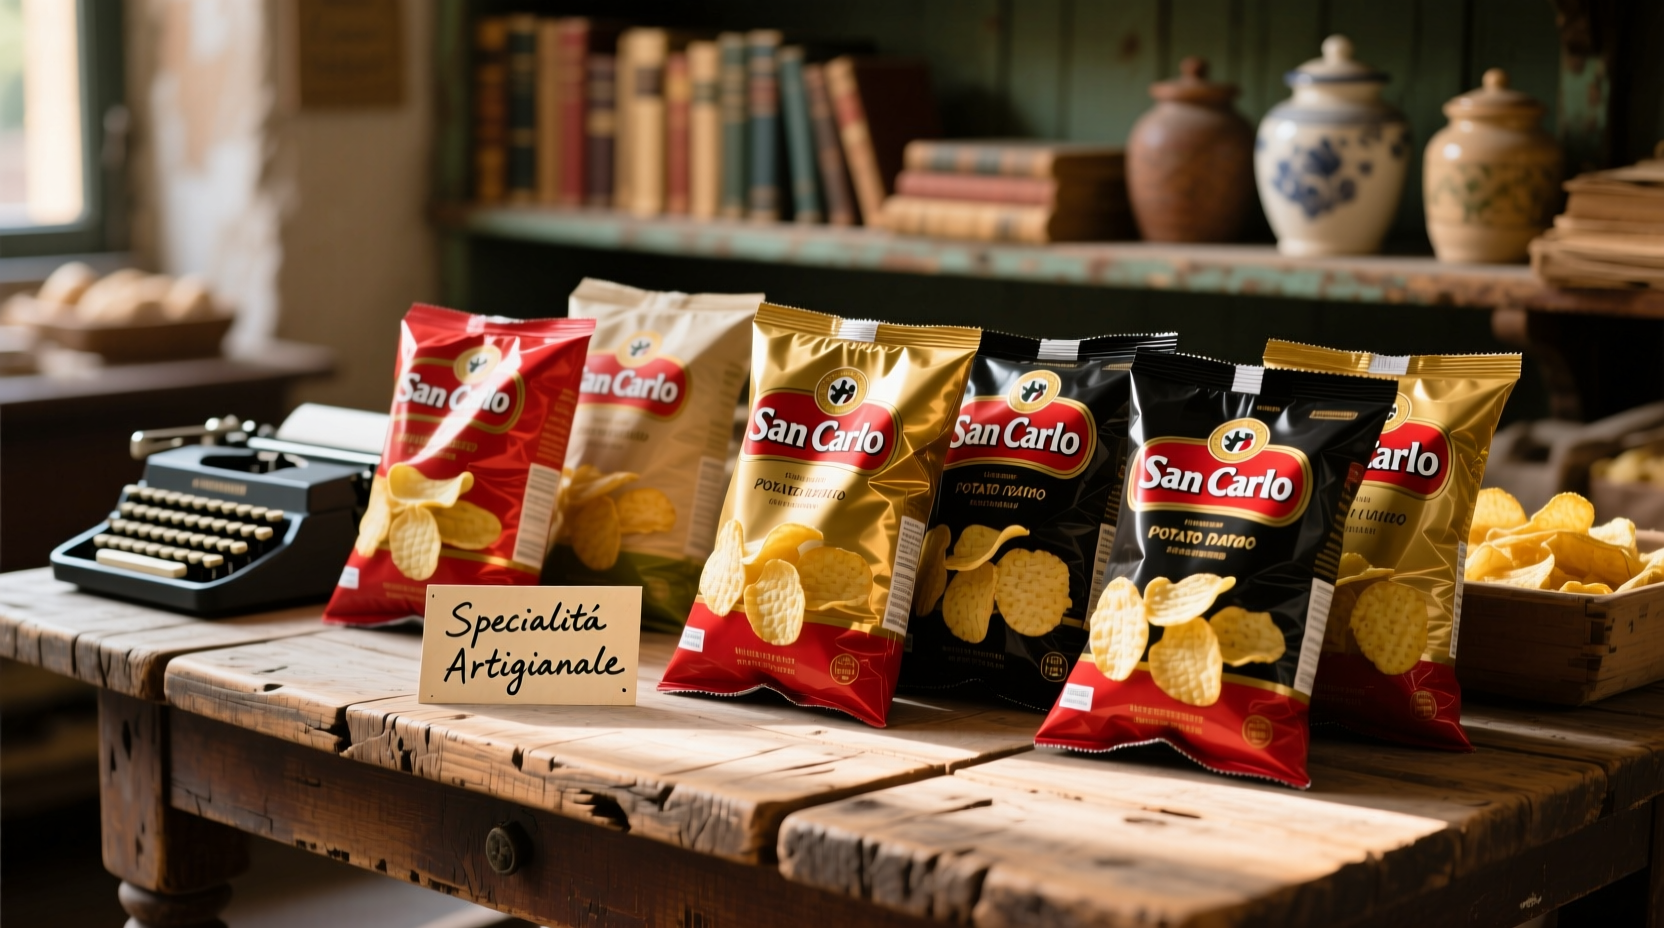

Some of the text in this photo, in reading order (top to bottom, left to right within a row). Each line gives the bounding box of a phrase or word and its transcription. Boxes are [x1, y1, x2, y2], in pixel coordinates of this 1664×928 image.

[396, 372, 448, 409] San
[580, 366, 679, 404] an Carlo
[748, 406, 809, 448] San
[811, 420, 884, 454] Carlo
[949, 414, 1080, 455] San Carlo
[1138, 454, 1293, 502] San Carlo
[1367, 440, 1439, 477] arlo
[1147, 525, 1203, 545] POTATO
[445, 601, 607, 648] Specialitá
[443, 645, 626, 696] Artigianale
